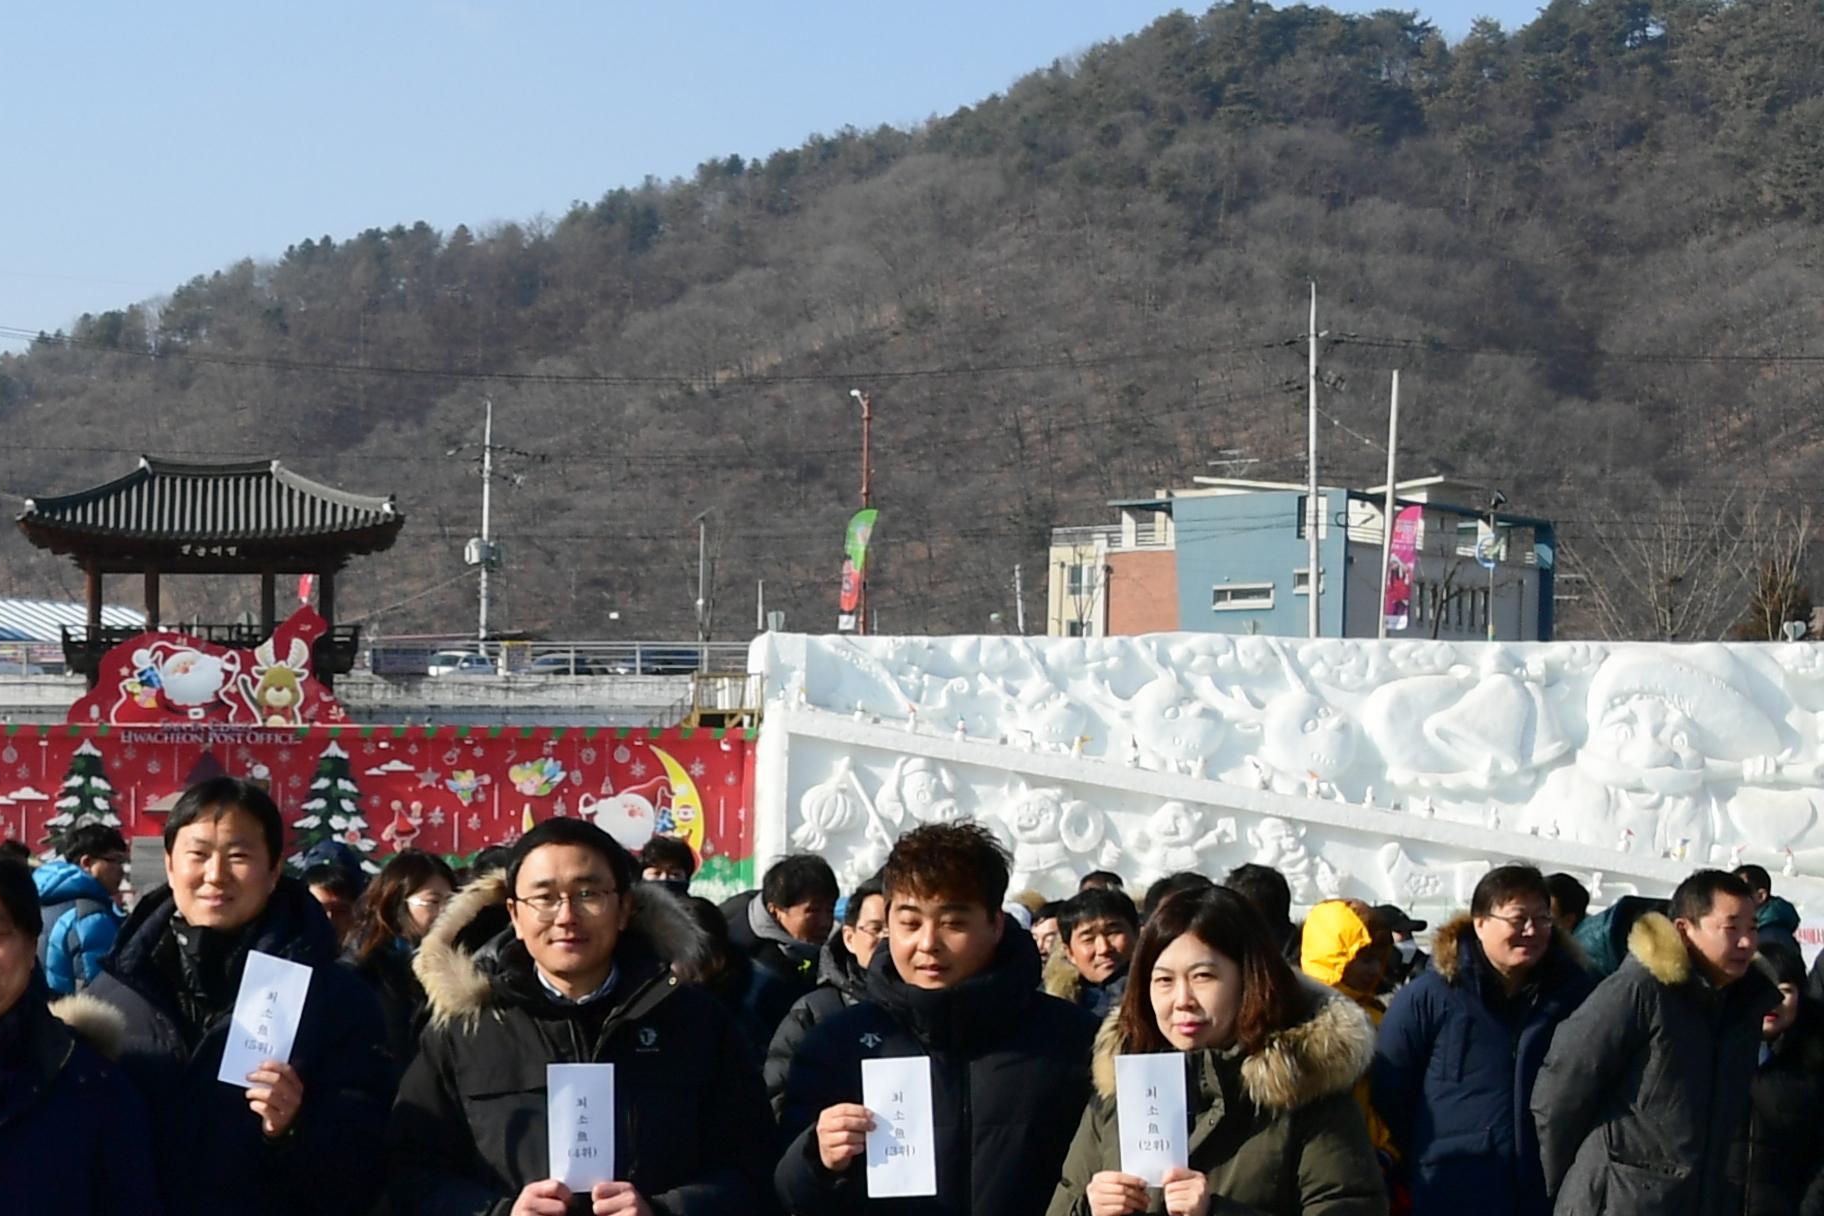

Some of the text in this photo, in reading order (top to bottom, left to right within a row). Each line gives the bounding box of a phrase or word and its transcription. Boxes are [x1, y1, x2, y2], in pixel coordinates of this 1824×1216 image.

[120, 731, 295, 744] HWACHEON POST OFFICE
